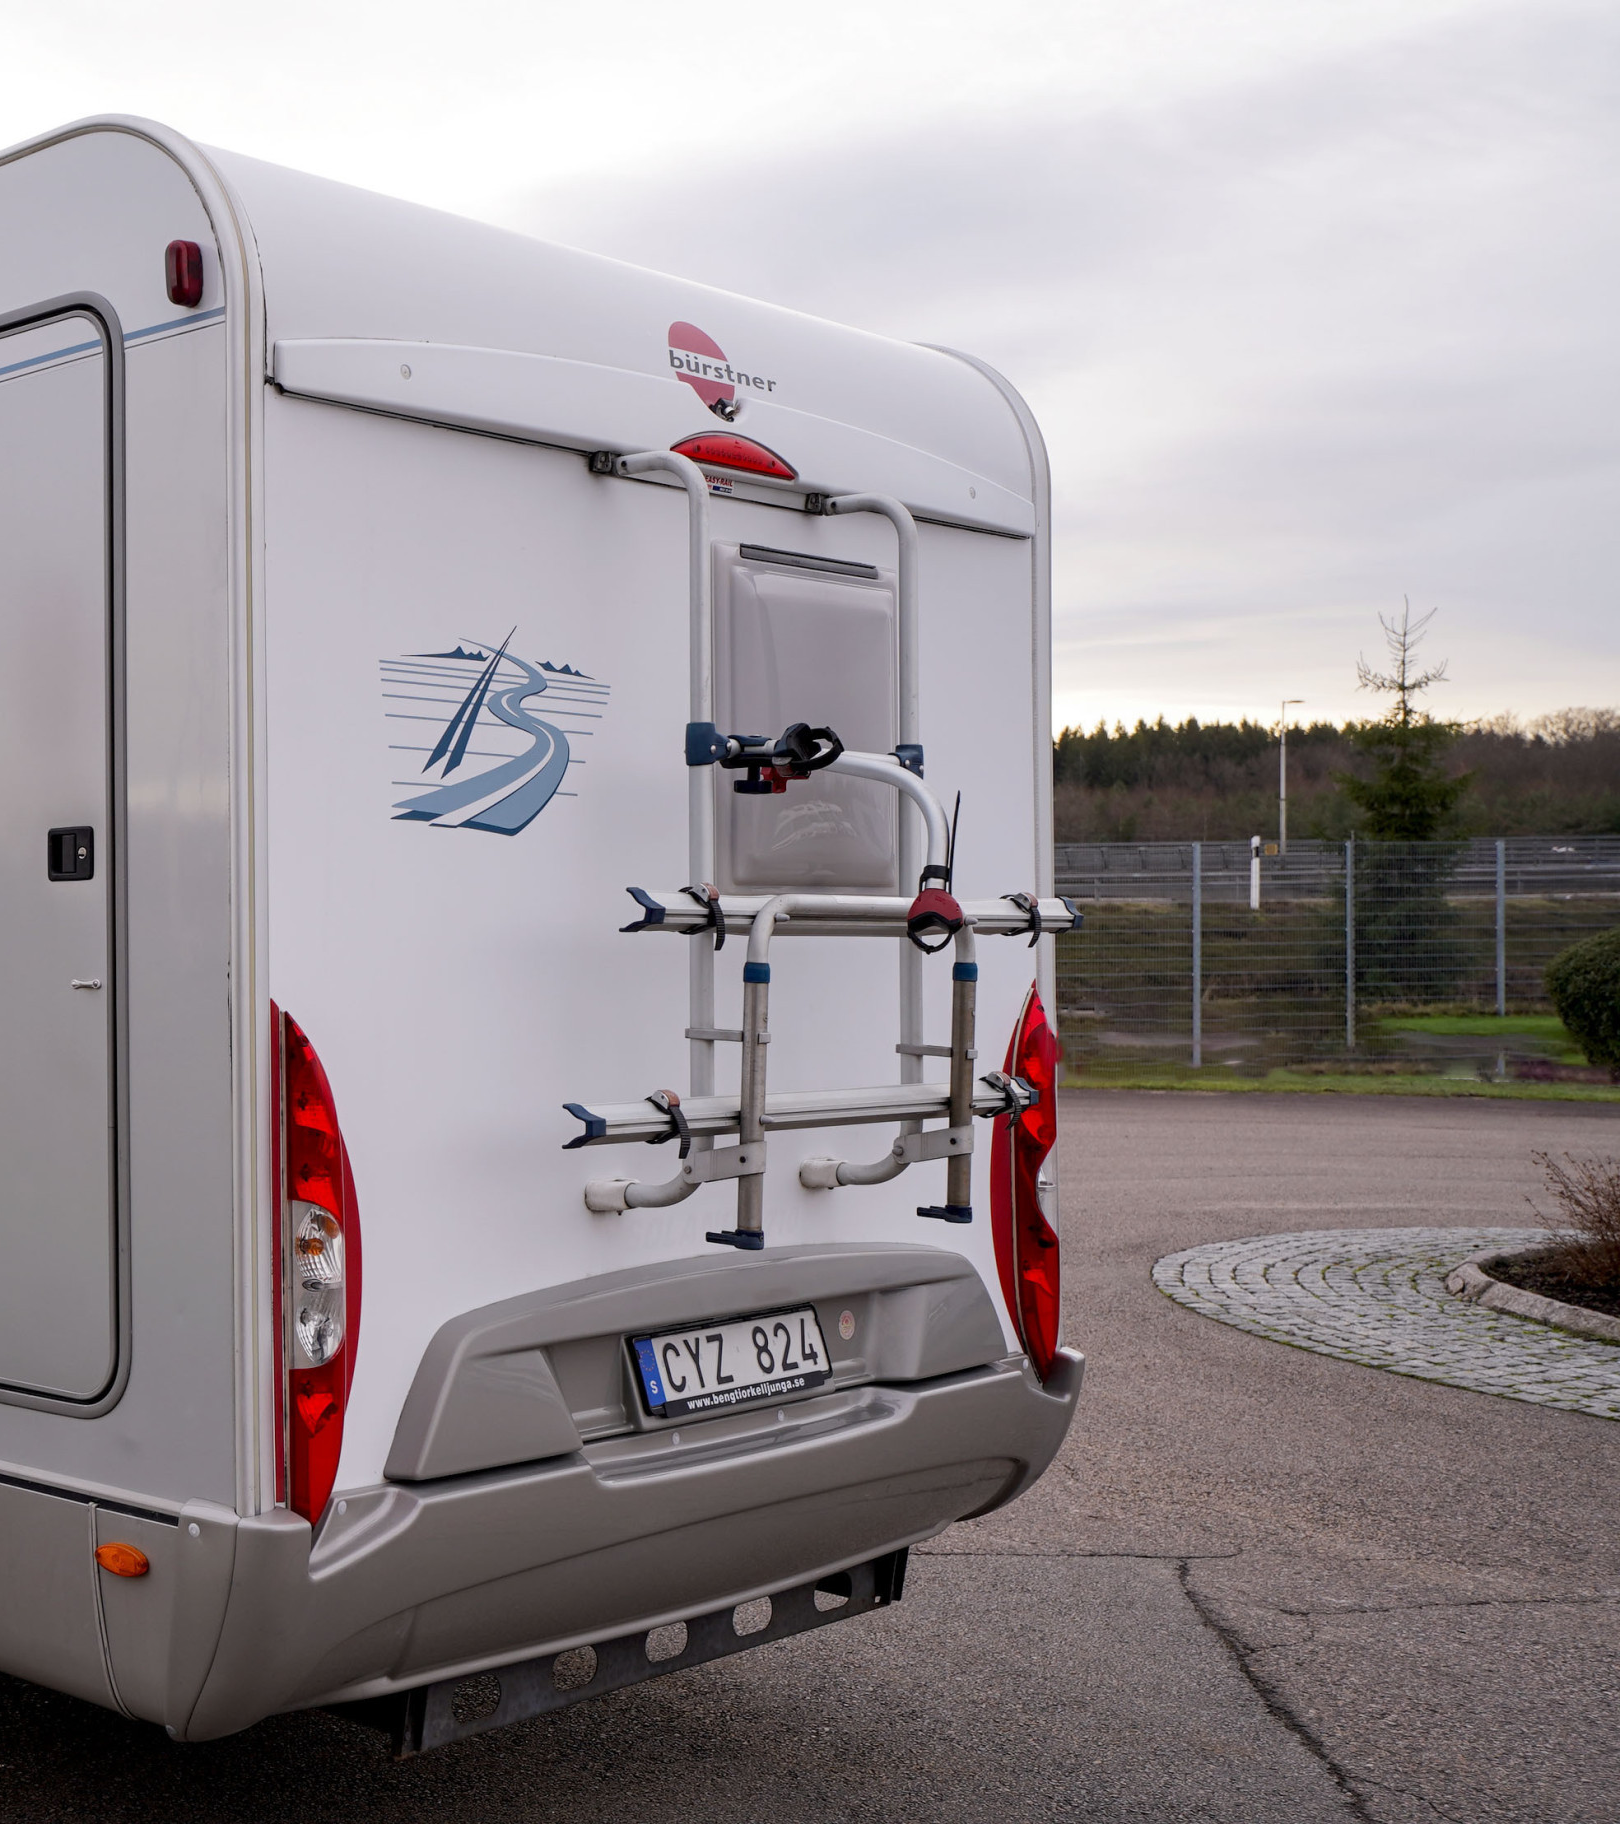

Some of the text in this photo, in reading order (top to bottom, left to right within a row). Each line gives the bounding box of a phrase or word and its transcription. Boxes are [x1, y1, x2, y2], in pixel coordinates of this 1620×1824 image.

[668, 349, 777, 392] bürstner
[662, 1333, 735, 1393] CYZ
[751, 1317, 819, 1375] 824
[649, 1380, 659, 1394] S
[686, 1376, 805, 1410] www.bengtiorkelljunga.se
